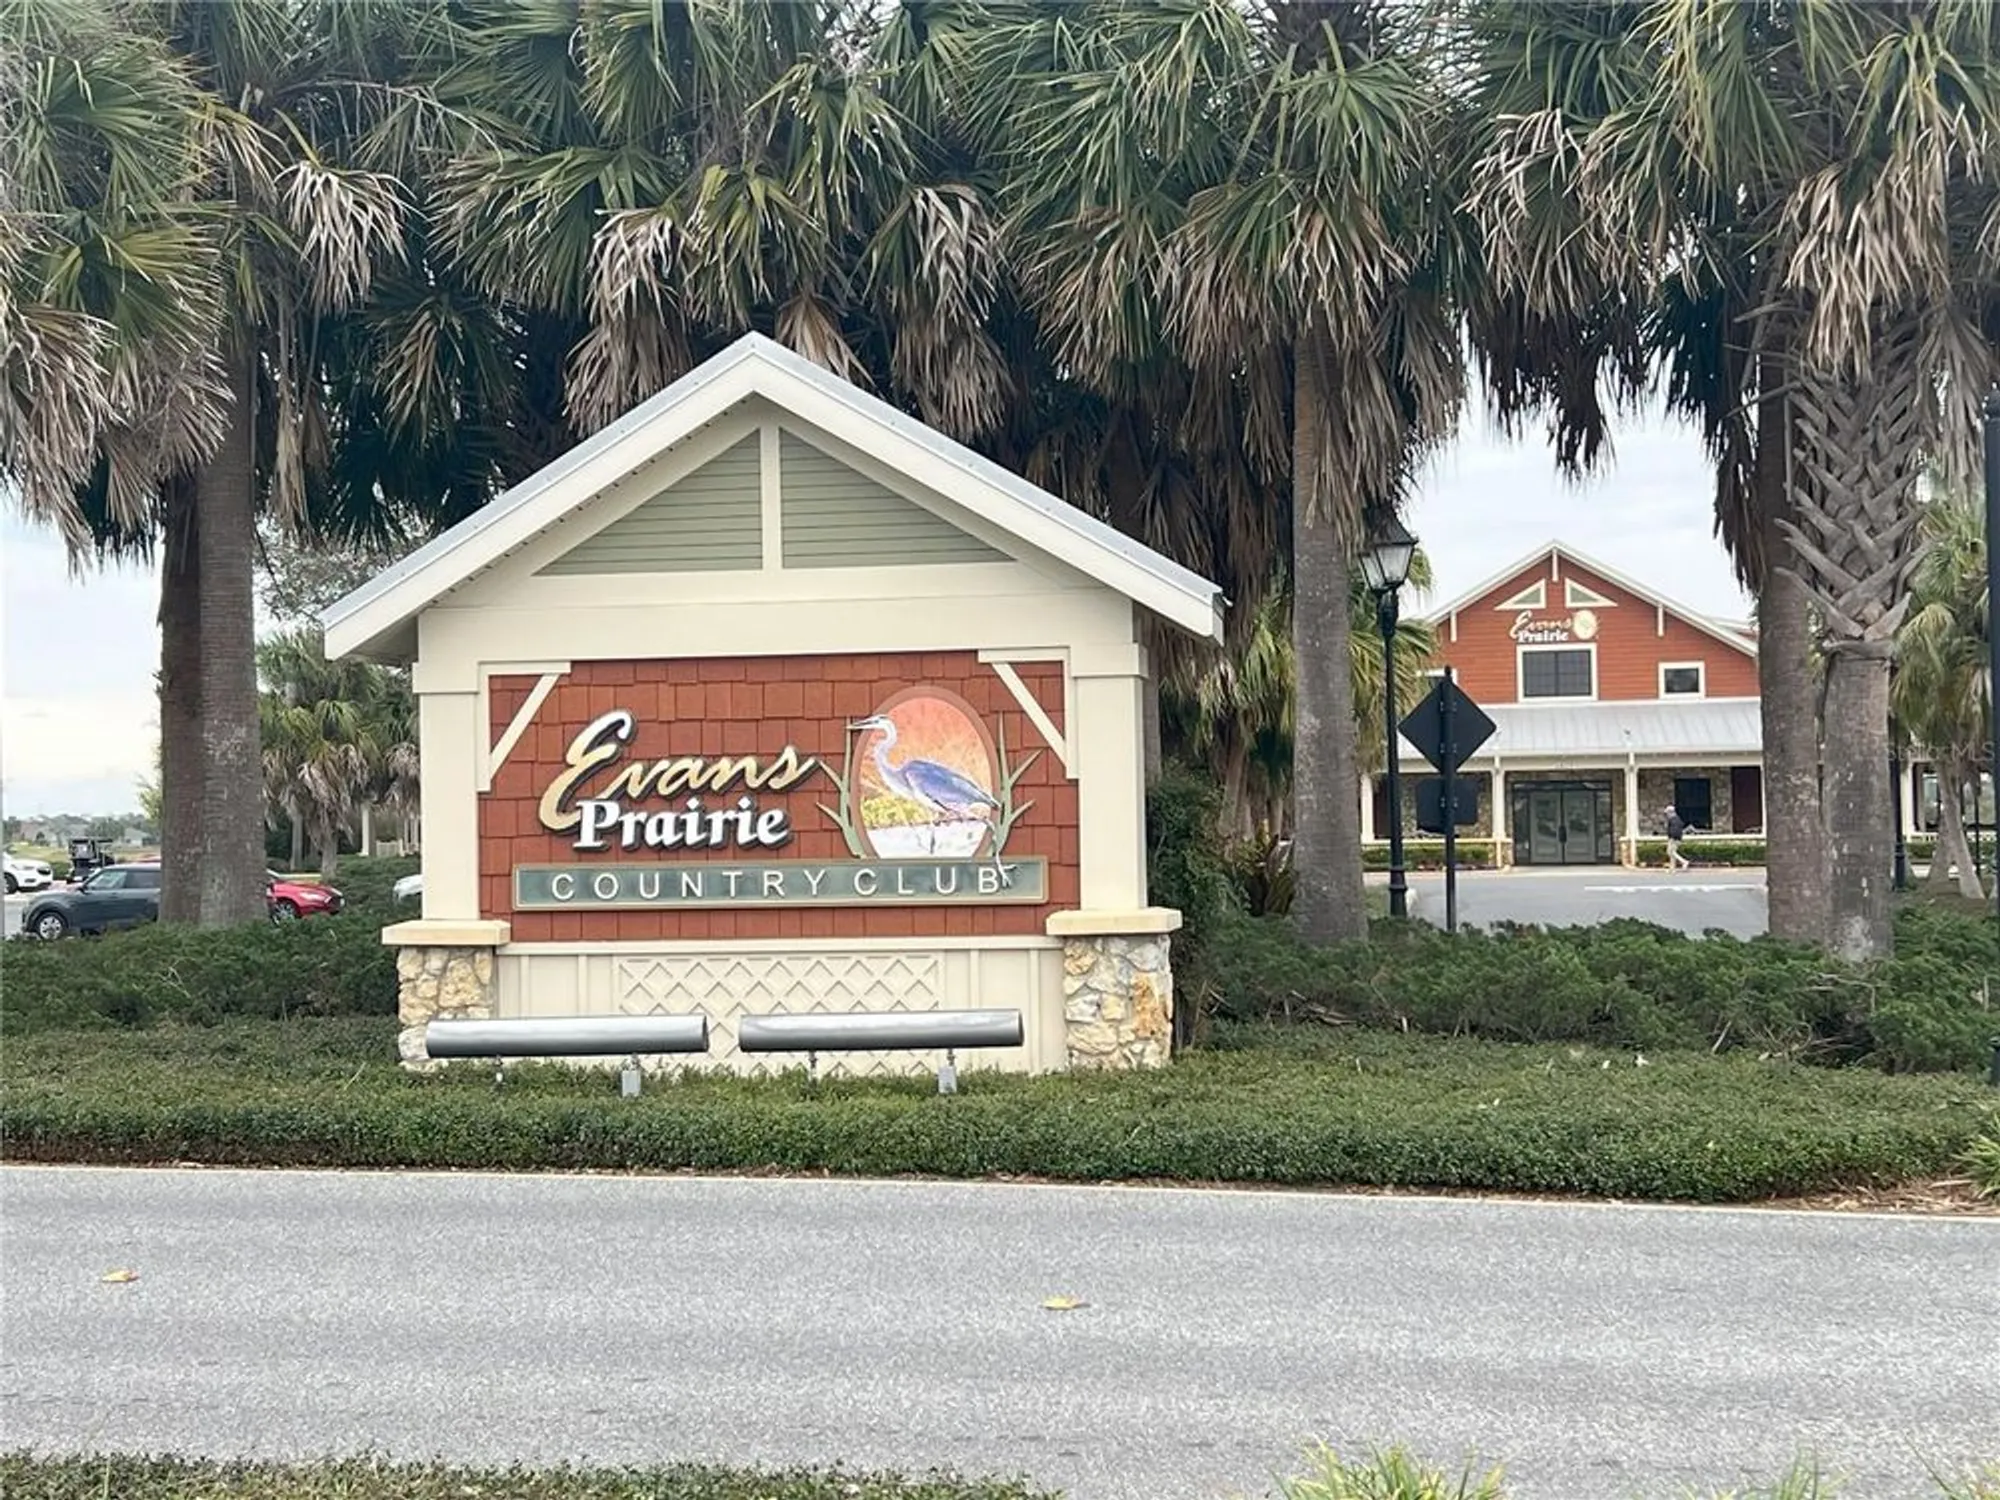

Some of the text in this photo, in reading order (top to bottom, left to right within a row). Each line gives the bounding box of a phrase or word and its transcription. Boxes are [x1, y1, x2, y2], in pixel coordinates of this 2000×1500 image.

[1509, 609, 1572, 640] Evans
[1518, 629, 1569, 642] Prairie
[539, 709, 817, 831] Evans
[573, 796, 789, 849] Prairie
[551, 866, 998, 900] COUNTRY CLUB
